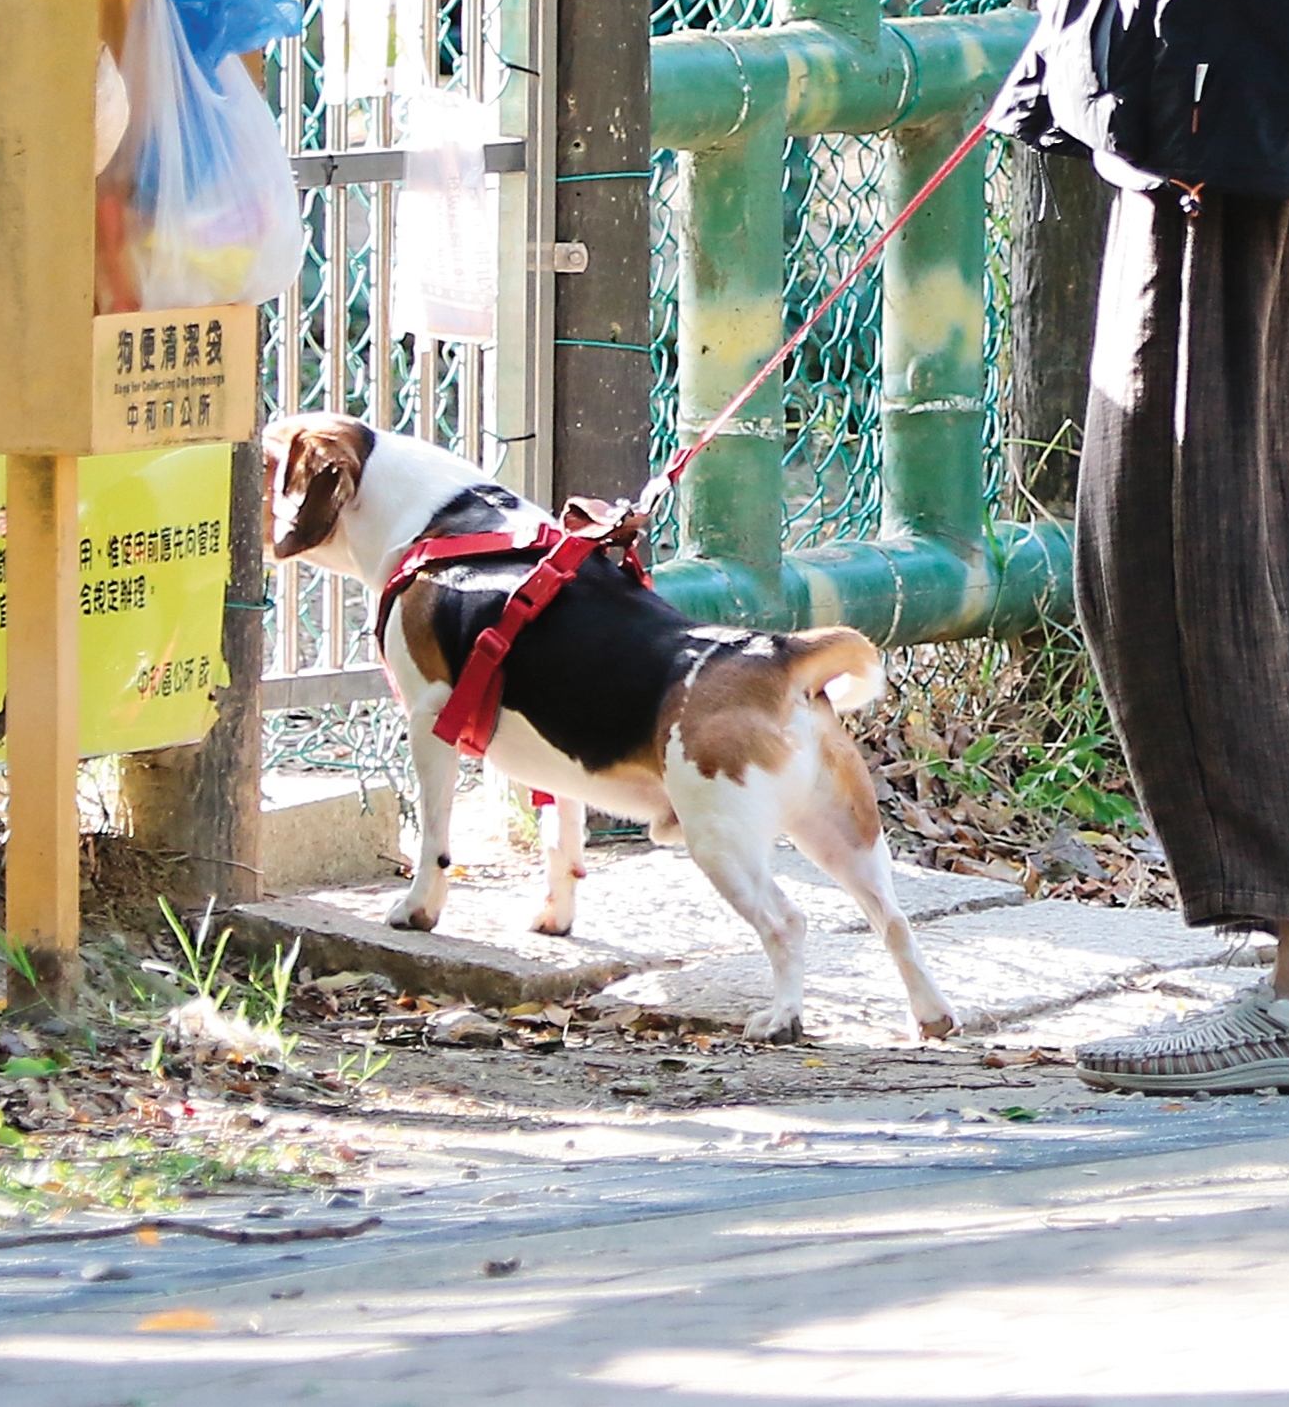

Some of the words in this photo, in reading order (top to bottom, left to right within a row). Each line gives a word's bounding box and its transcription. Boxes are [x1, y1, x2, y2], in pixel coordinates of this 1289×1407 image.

[117, 319, 223, 375] 狗便清潔袋
[126, 393, 211, 434] 中和市公所
